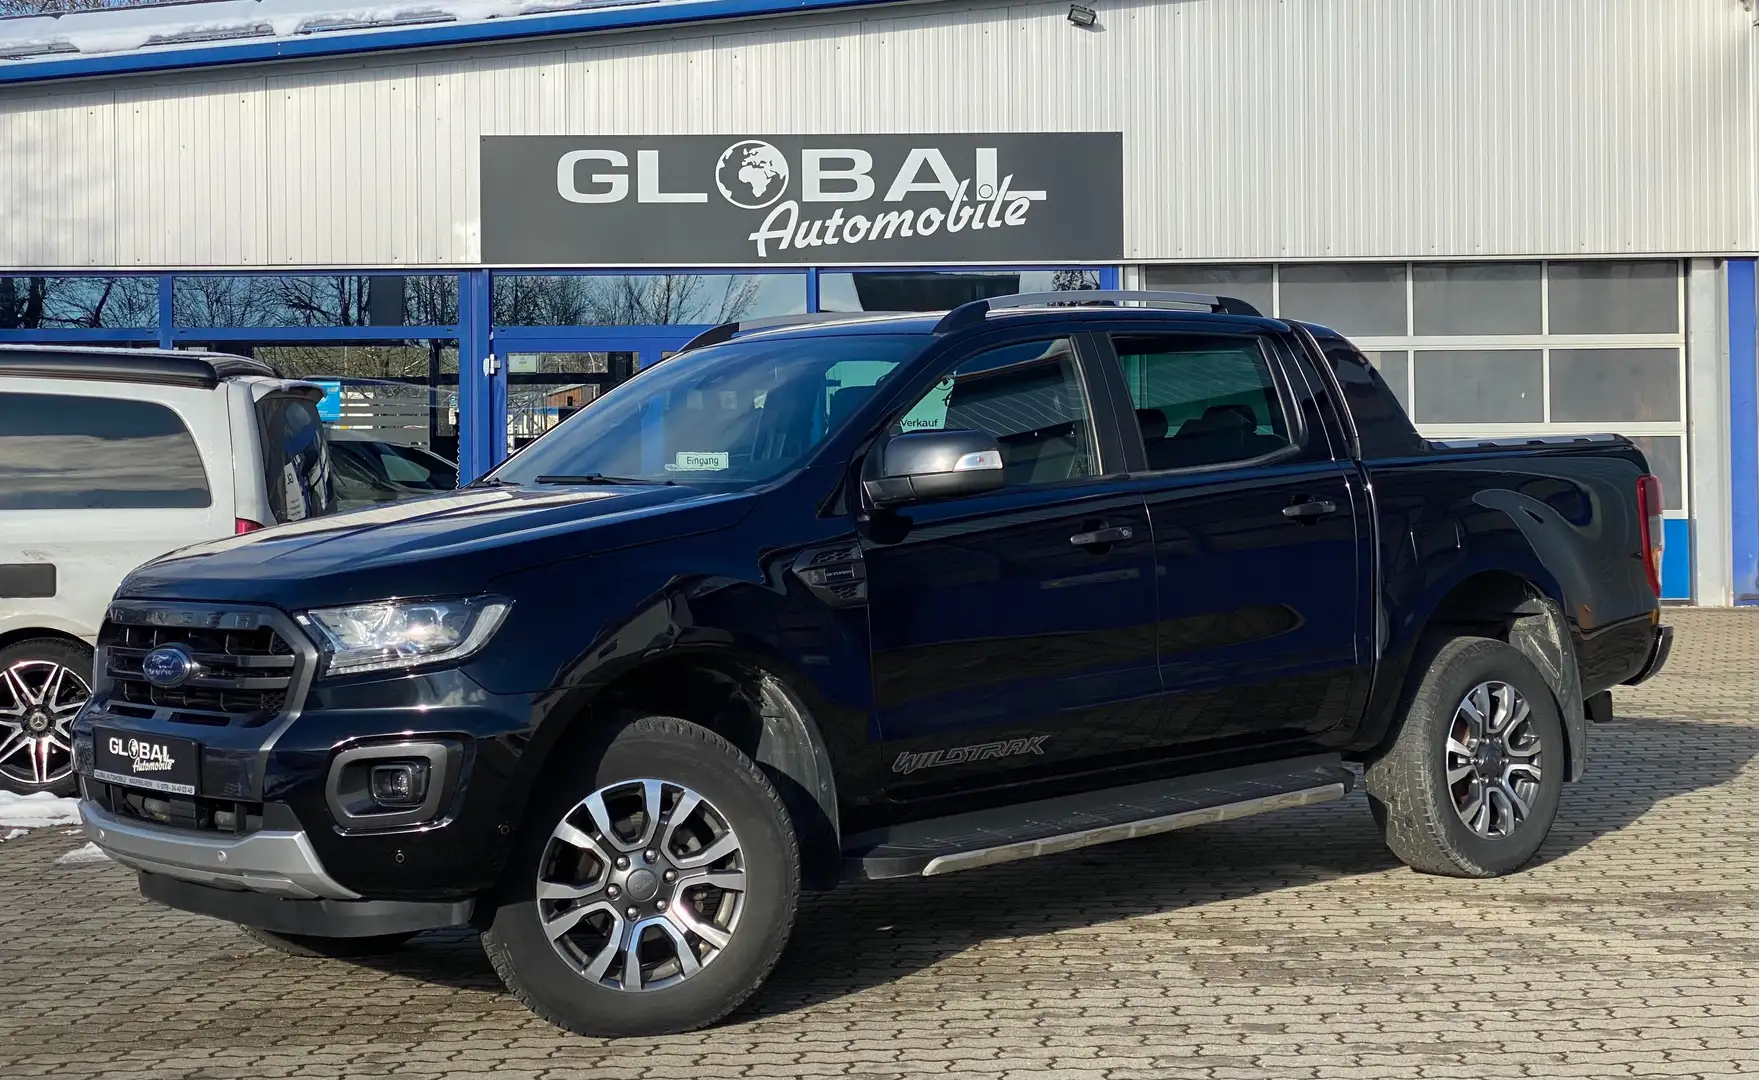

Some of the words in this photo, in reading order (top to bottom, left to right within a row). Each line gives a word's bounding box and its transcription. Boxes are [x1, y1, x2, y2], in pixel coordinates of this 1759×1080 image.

[557, 140, 1047, 210] GLOBAL
[748, 174, 1031, 258] Automobile
[900, 418, 939, 427] Verkauf
[686, 456, 719, 467] Eingang
[109, 737, 175, 764] GLOBAL
[132, 754, 173, 773] Automobile
[892, 735, 1051, 774] WILDTRAK
